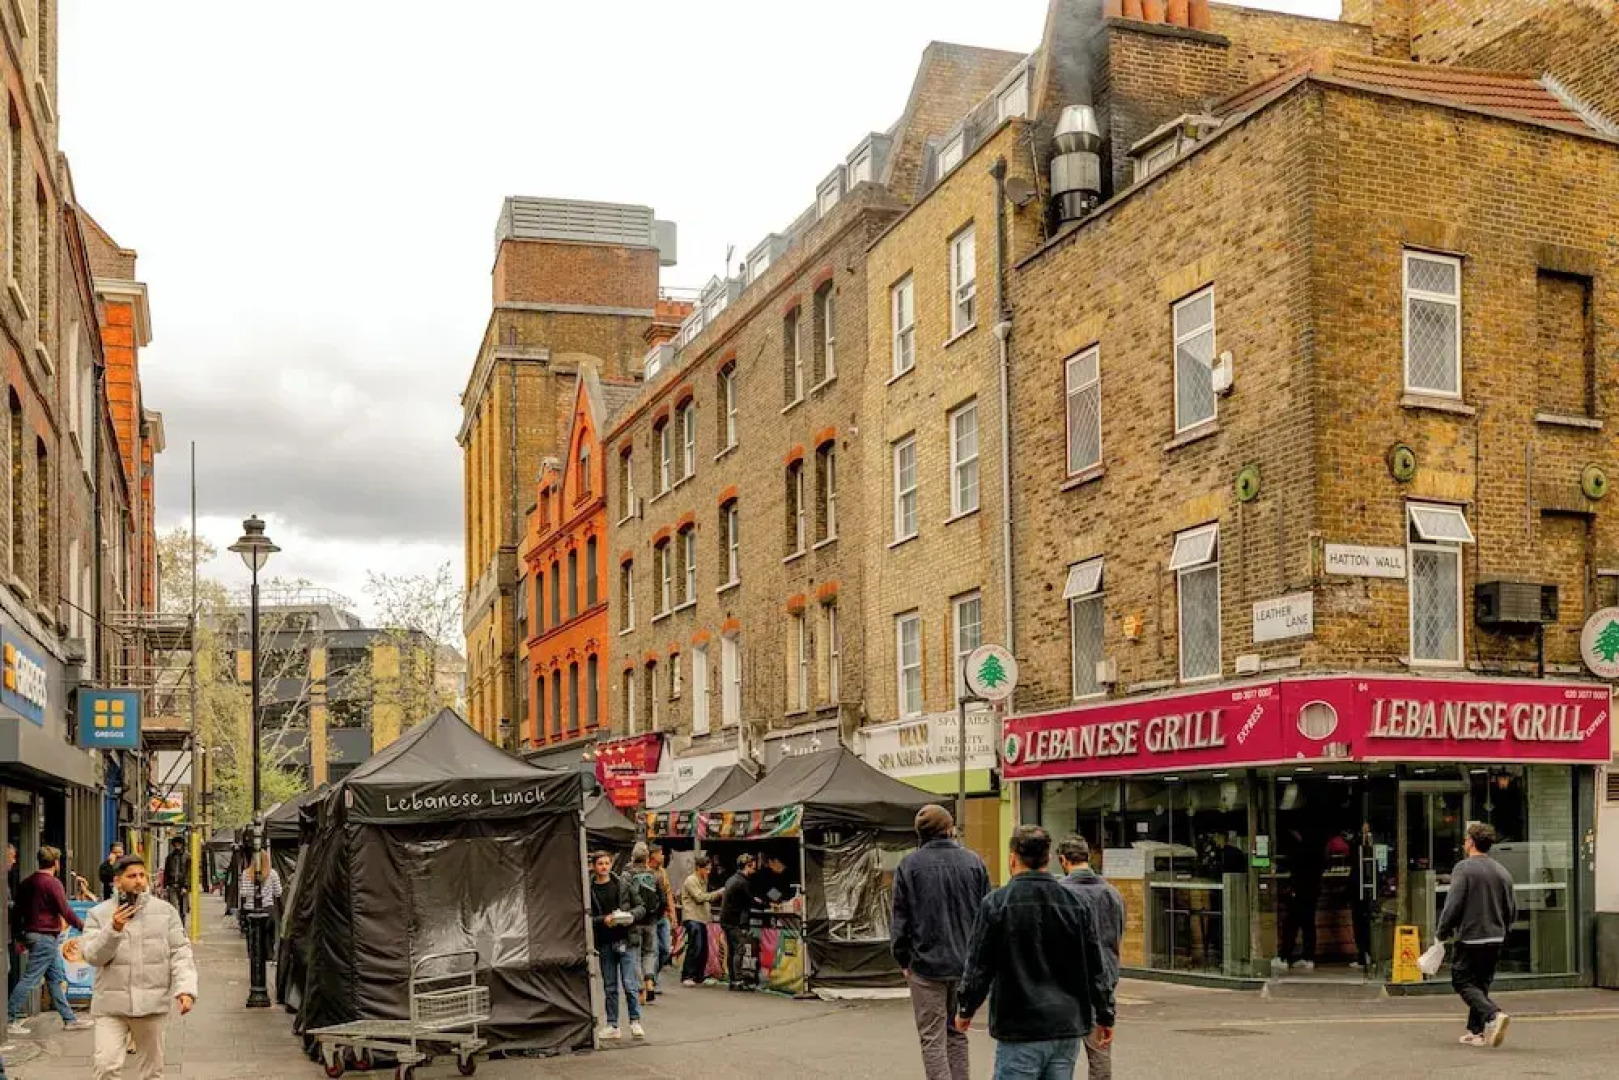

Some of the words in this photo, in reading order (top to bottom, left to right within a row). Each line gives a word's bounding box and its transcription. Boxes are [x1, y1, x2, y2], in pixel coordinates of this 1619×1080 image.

[1329, 553, 1369, 566] HATTON
[1375, 556, 1401, 568] WALL
[1256, 605, 1292, 622] LEATHER
[1286, 613, 1308, 628] LANE
[938, 716, 957, 726] SPA
[1371, 698, 1508, 740] LEBANESE
[1512, 702, 1585, 741] GRILL
[1024, 719, 1141, 763] LEBANESE
[1145, 709, 1225, 752] GRILL
[386, 792, 482, 812] Lebanese
[491, 786, 546, 806] Lunch
